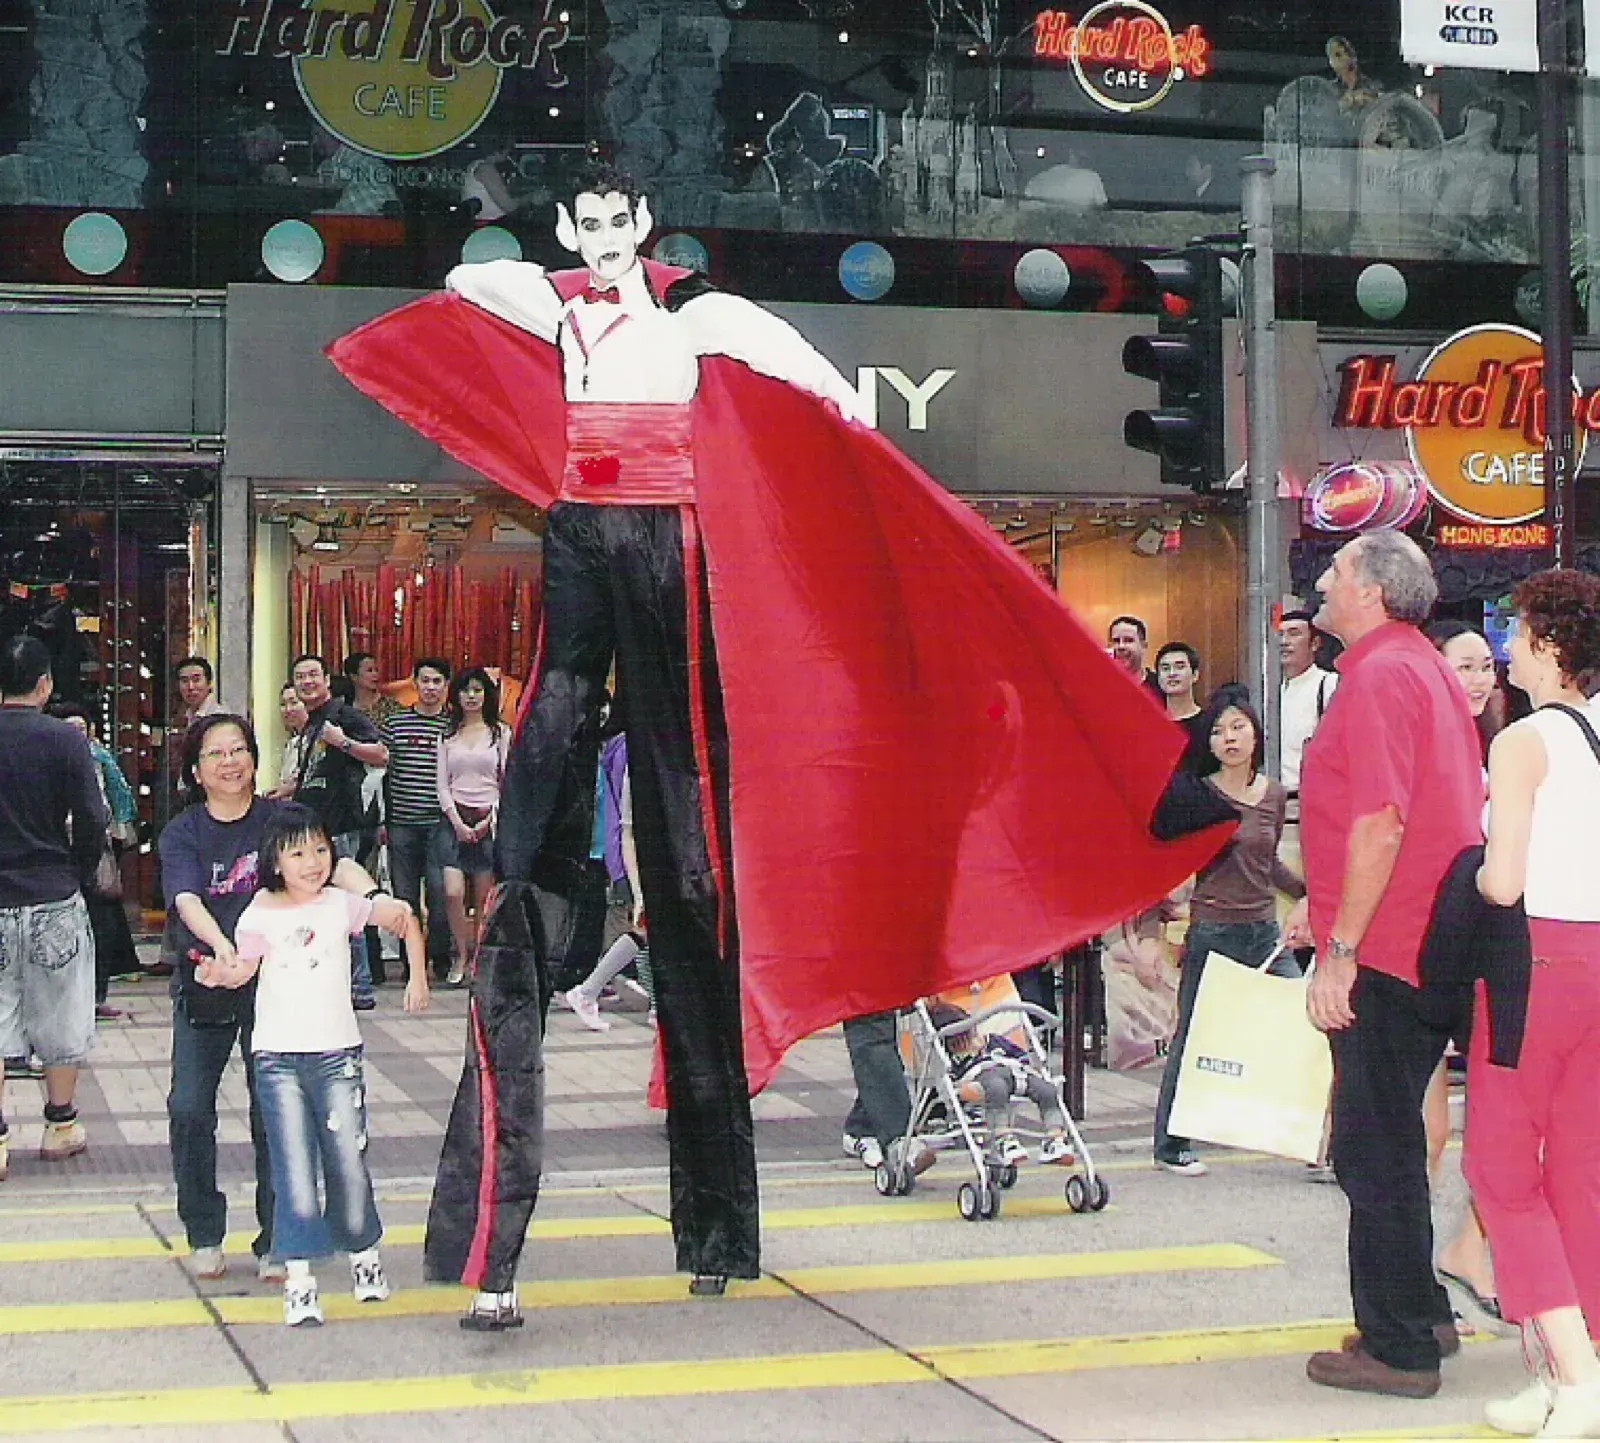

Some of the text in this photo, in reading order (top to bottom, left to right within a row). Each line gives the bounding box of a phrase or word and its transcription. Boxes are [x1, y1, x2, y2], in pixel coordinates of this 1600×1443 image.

[1445, 5, 1494, 23] KCR
[215, 0, 570, 87] Hard Rock
[1034, 10, 1208, 77] Hard Rock
[1103, 67, 1149, 90] CAFE
[353, 83, 447, 120] CAFE
[1332, 355, 1501, 429] Hard
[1463, 451, 1545, 486] CAFE
[1441, 525, 1495, 545] HONG
